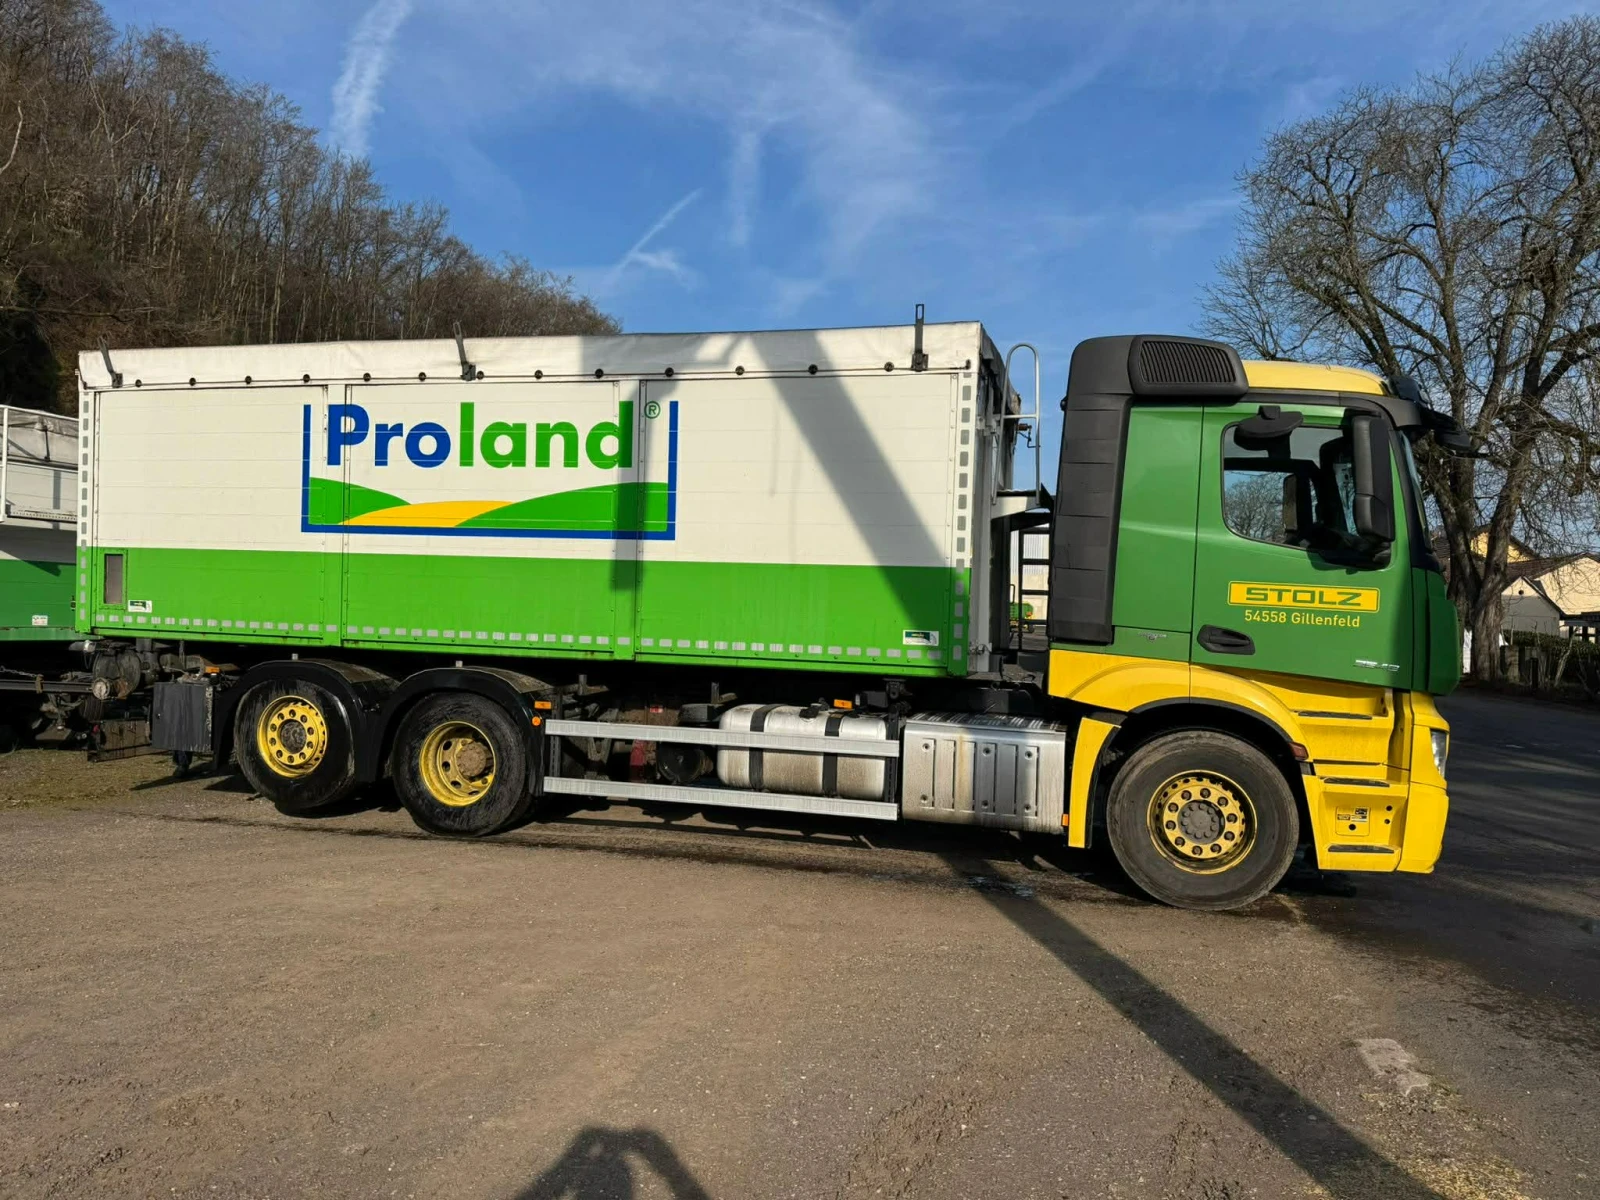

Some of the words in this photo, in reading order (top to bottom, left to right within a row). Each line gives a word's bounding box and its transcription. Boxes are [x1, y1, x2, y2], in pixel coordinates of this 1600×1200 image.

[327, 401, 633, 469] Proland
[1246, 587, 1362, 606] STOLZ
[1245, 609, 1286, 623] 54558
[1291, 612, 1360, 627] Gillenfeld
